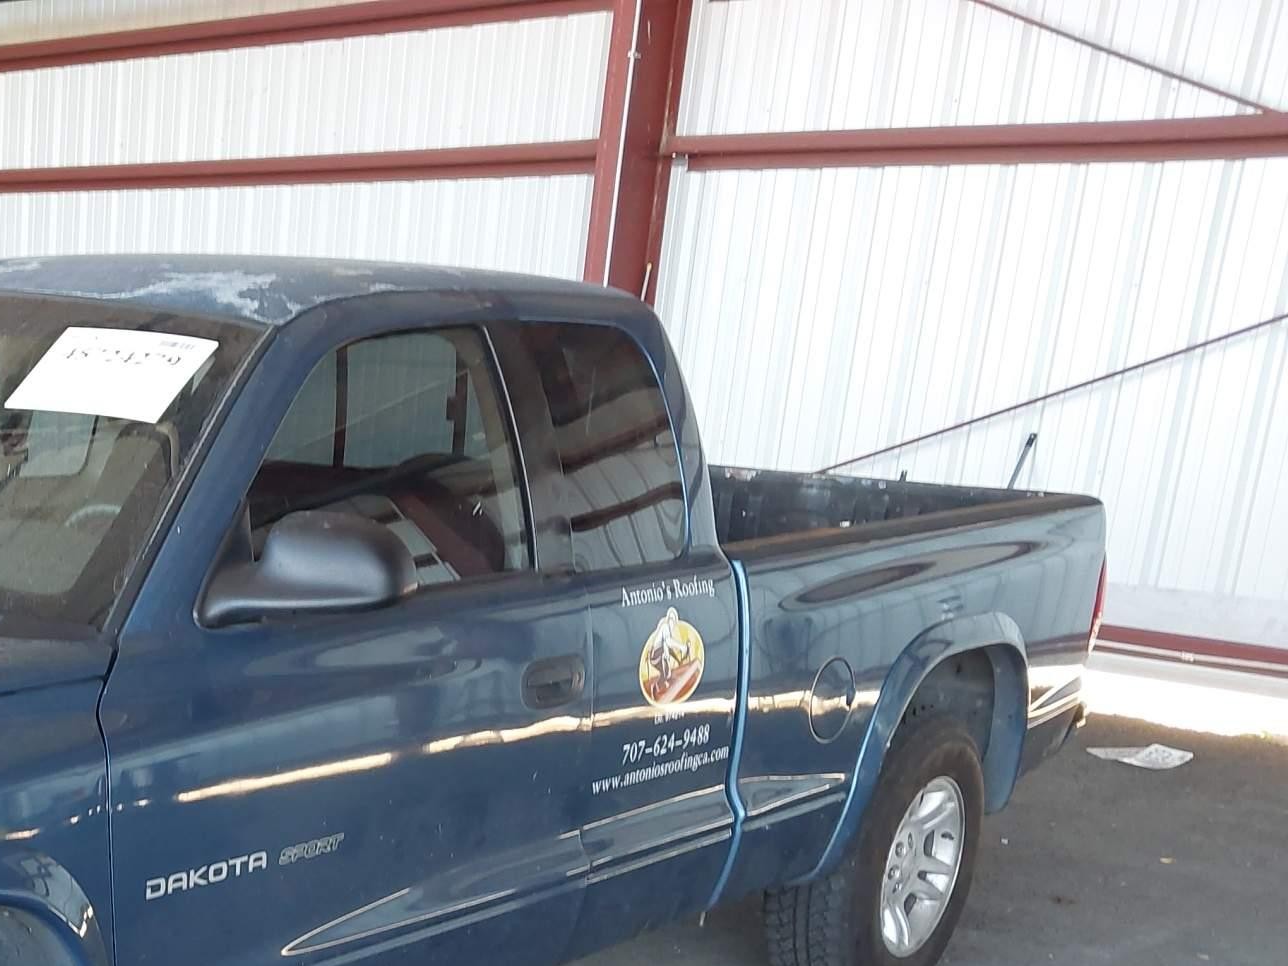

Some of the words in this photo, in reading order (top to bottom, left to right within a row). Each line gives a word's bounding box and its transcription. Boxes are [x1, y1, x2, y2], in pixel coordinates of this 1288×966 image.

[621, 582, 672, 607] Antonio's
[673, 575, 715, 599] Roofing
[622, 724, 710, 765] 707-624-9488
[592, 745, 729, 795] www.antoniosroofingca.com
[145, 851, 268, 900] DAKOTA
[278, 832, 345, 866] SPORT
